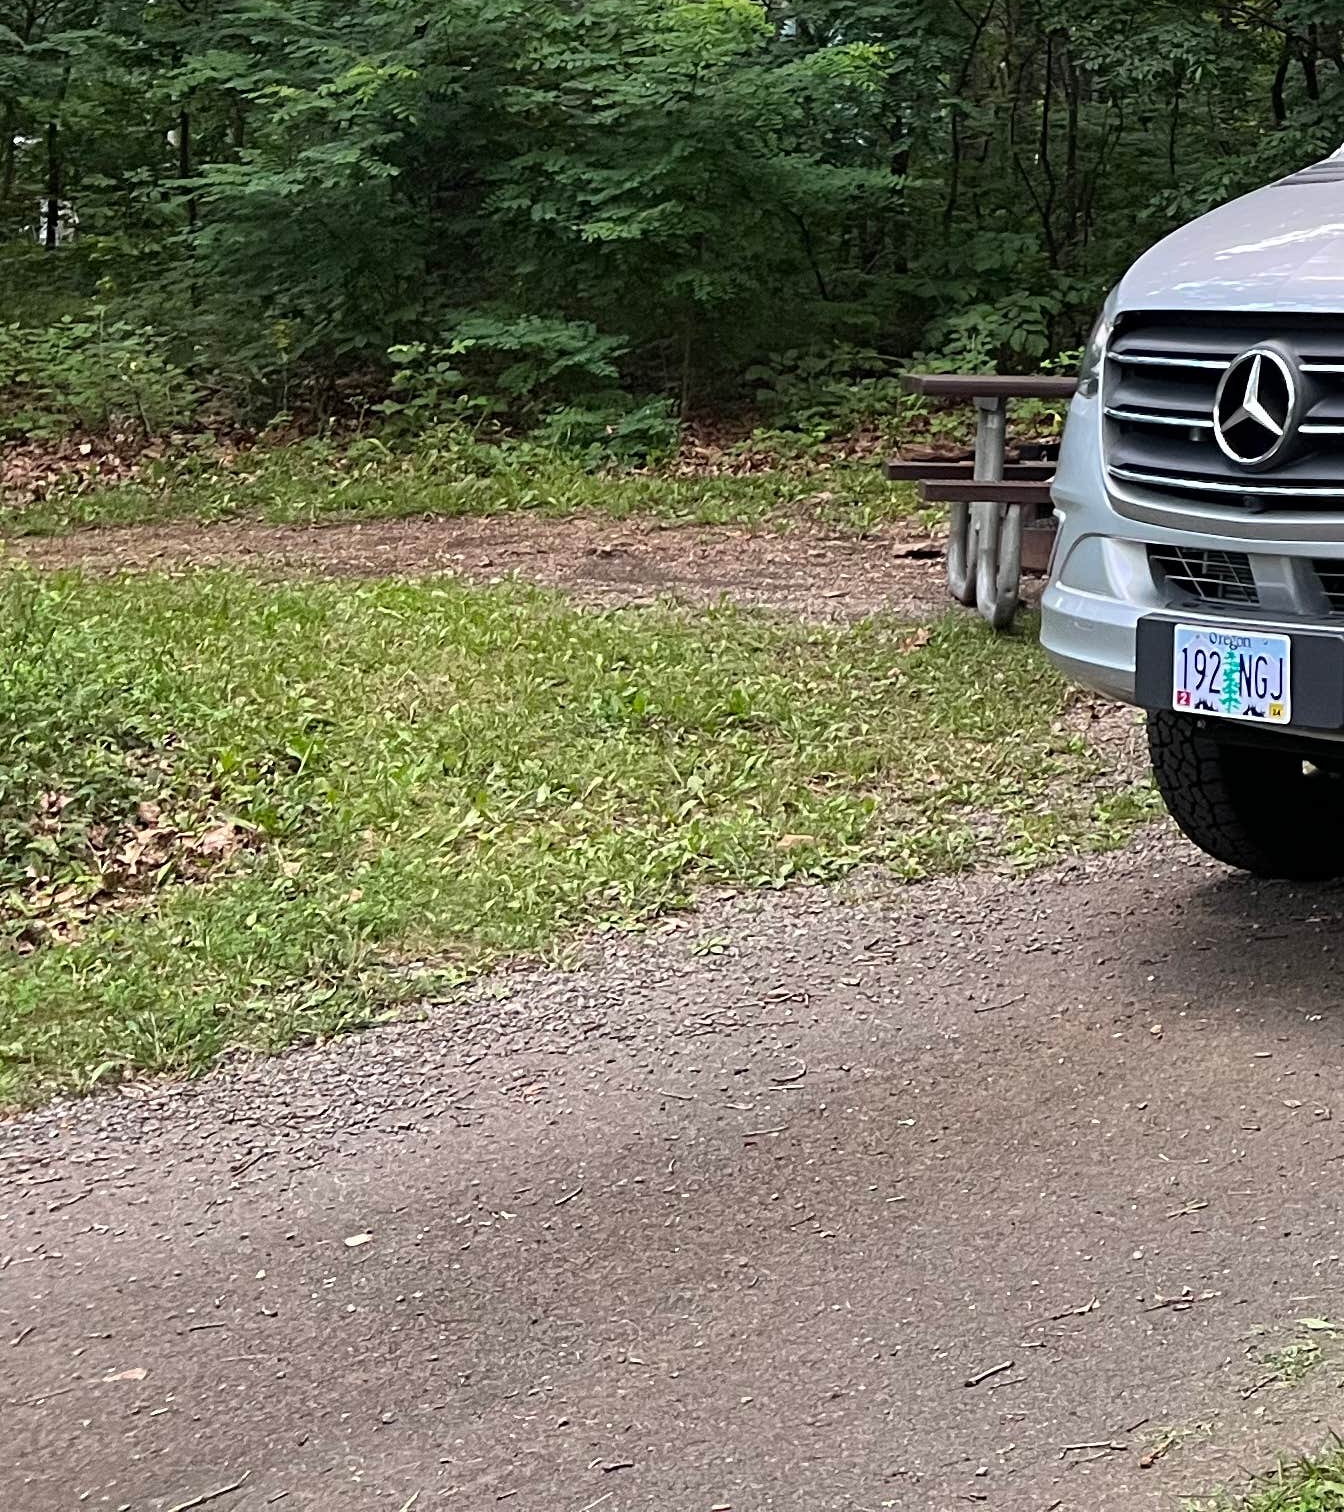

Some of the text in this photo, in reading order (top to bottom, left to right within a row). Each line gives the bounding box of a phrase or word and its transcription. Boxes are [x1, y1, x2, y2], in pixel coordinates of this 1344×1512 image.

[1209, 632, 1251, 650] Oregon
[1182, 648, 1283, 700] 192 NGJ
[1179, 693, 1188, 704] 2
